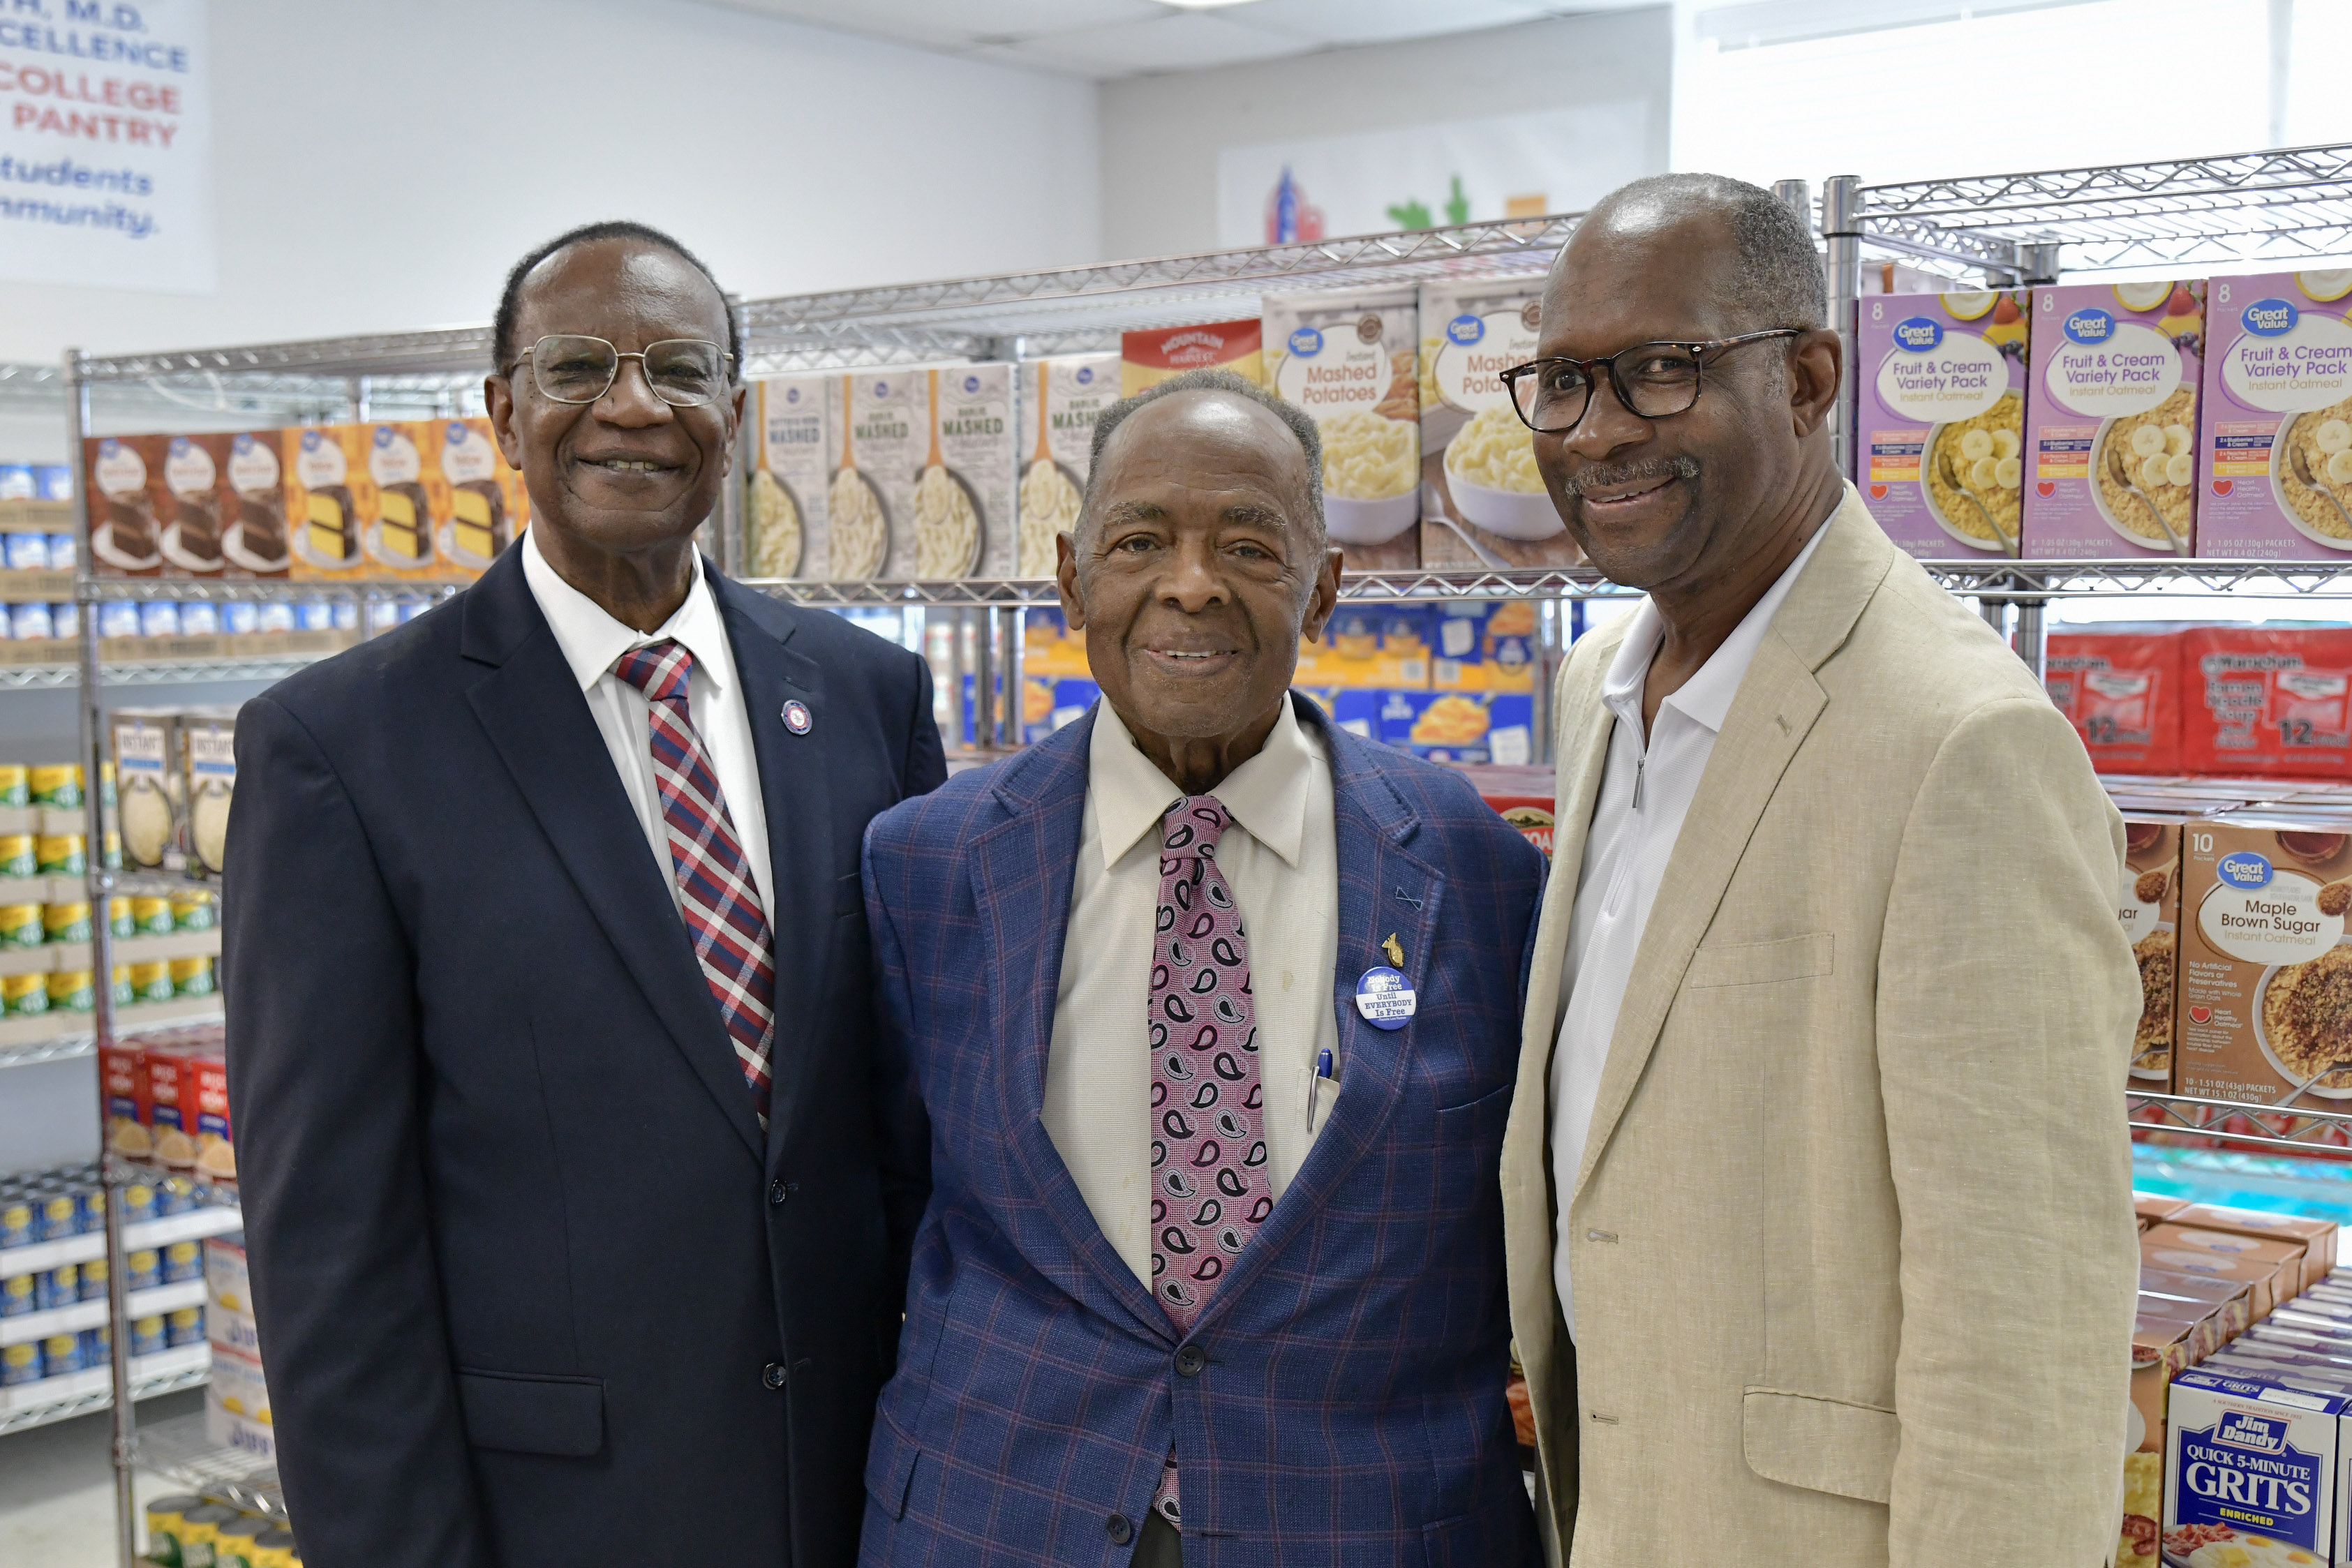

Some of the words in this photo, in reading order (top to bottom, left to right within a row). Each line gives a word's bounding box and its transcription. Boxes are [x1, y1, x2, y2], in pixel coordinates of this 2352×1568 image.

[0, 0, 52, 20] H.
[66, 0, 149, 33] M.D.
[13, 102, 179, 149] PANTRY
[2217, 283, 2231, 303] 8
[1872, 302, 1883, 321] 8
[2042, 294, 2054, 313] 8
[2247, 307, 2288, 322] Great
[1450, 320, 1479, 334] Great
[1898, 324, 1935, 338] Great
[2069, 316, 2106, 330] Great
[2256, 320, 2288, 330] Value
[1291, 333, 1318, 347] Great
[1906, 336, 1935, 345] Value
[2078, 328, 2106, 338] Value
[1510, 338, 1537, 350] Instan
[2063, 355, 2092, 368] Fruit
[2097, 354, 2107, 367] &
[2112, 354, 2165, 366] Cream
[2241, 348, 2273, 361] Fruit
[2278, 347, 2289, 360] &
[2295, 346, 2352, 360] Cream
[1468, 352, 1538, 373] Mashe
[1893, 361, 1922, 375] Fruit
[1926, 361, 1936, 374] &
[1941, 361, 1992, 374] Cream
[2245, 363, 2301, 378] Variety
[2306, 360, 2348, 375] Pack
[1307, 363, 1377, 384] Mashed
[2066, 371, 2117, 384] Variety
[2122, 368, 2160, 382] Pack
[1896, 378, 1947, 391] Variety
[1951, 375, 1988, 388] Pack
[2069, 386, 2104, 396] Instant
[2106, 385, 2156, 396] Oatmeal
[2249, 380, 2286, 391] Instant
[2289, 378, 2342, 390] Oatmeal
[1302, 384, 1377, 404] Potatoes
[1900, 392, 1933, 403] Instant
[1936, 391, 1983, 402] Oatmeal
[943, 418, 1004, 435] MASHED
[1052, 410, 1099, 428] MASH
[854, 421, 908, 440] MASHED
[2085, 538, 2113, 547] PACKETS
[2245, 539, 2264, 548] (30g)
[2257, 549, 2281, 558] (240g)
[2087, 715, 2116, 742] 12
[2279, 718, 2313, 745] 12
[2192, 833, 2213, 853] 10
[2224, 860, 2264, 876] Great
[2233, 872, 2263, 883] Value
[2245, 900, 2297, 917] Maple
[2221, 913, 2268, 929] Brown
[2272, 916, 2321, 934] Sugar
[2224, 930, 2261, 942] Instant
[2265, 932, 2316, 946] Oatmeal
[2189, 969, 2215, 978] Flavors
[2201, 962, 2232, 971] Artificial
[1383, 983, 1402, 992] Free
[2188, 977, 2238, 988] Preservatives
[1376, 992, 1397, 1000] Until
[1364, 999, 1413, 1010] EVERYBODY
[1385, 1008, 1406, 1016] Free
[2185, 1077, 2194, 1085] 10
[2199, 1078, 2214, 1087] 1.51
[2215, 1079, 2225, 1088] OZ
[2226, 1080, 2245, 1091] (43g)
[2246, 1082, 2277, 1093] PACKETS
[2184, 1087, 2198, 1095] NET
[2198, 1088, 2210, 1096] WT
[2211, 1089, 2226, 1098] 15.1
[2228, 1090, 2237, 1099] OZ
[2238, 1091, 2262, 1103] (430g)
[2245, 1405, 2273, 1414] TRADITION
[2235, 1415, 2270, 1433] Jim
[2221, 1425, 2279, 1449] Dandy
[2186, 1444, 2234, 1466] QUICK
[2237, 1455, 2311, 1481] 5-MINUTE
[2186, 1461, 2312, 1515] GRITS
[2219, 1507, 2275, 1527] ENRICHED
